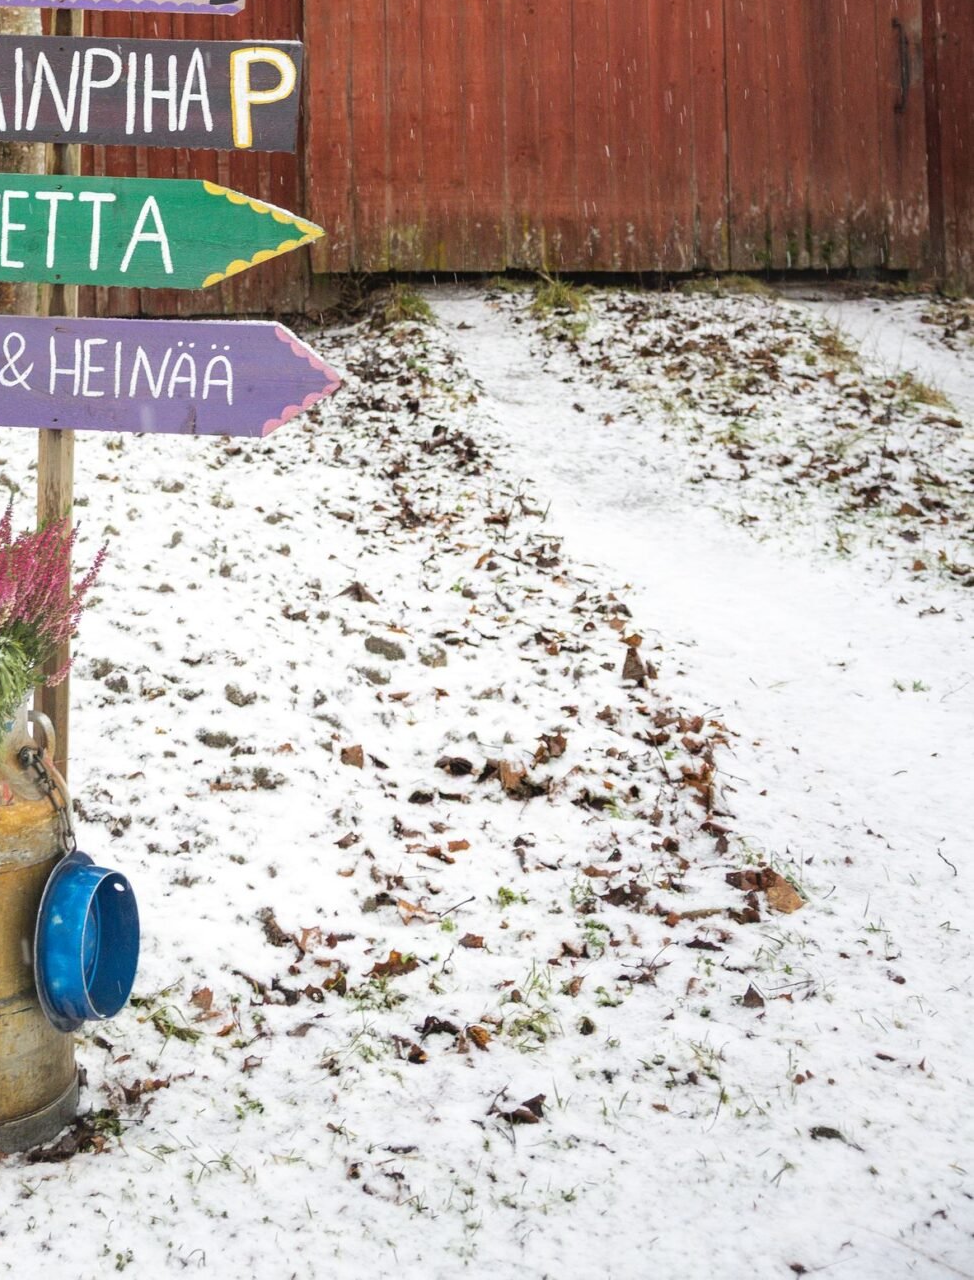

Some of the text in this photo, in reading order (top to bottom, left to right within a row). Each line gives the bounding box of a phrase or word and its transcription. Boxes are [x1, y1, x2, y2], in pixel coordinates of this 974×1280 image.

[230, 47, 297, 149] P
[0, 332, 35, 390] &
[49, 335, 234, 405] HEINÄÄ
